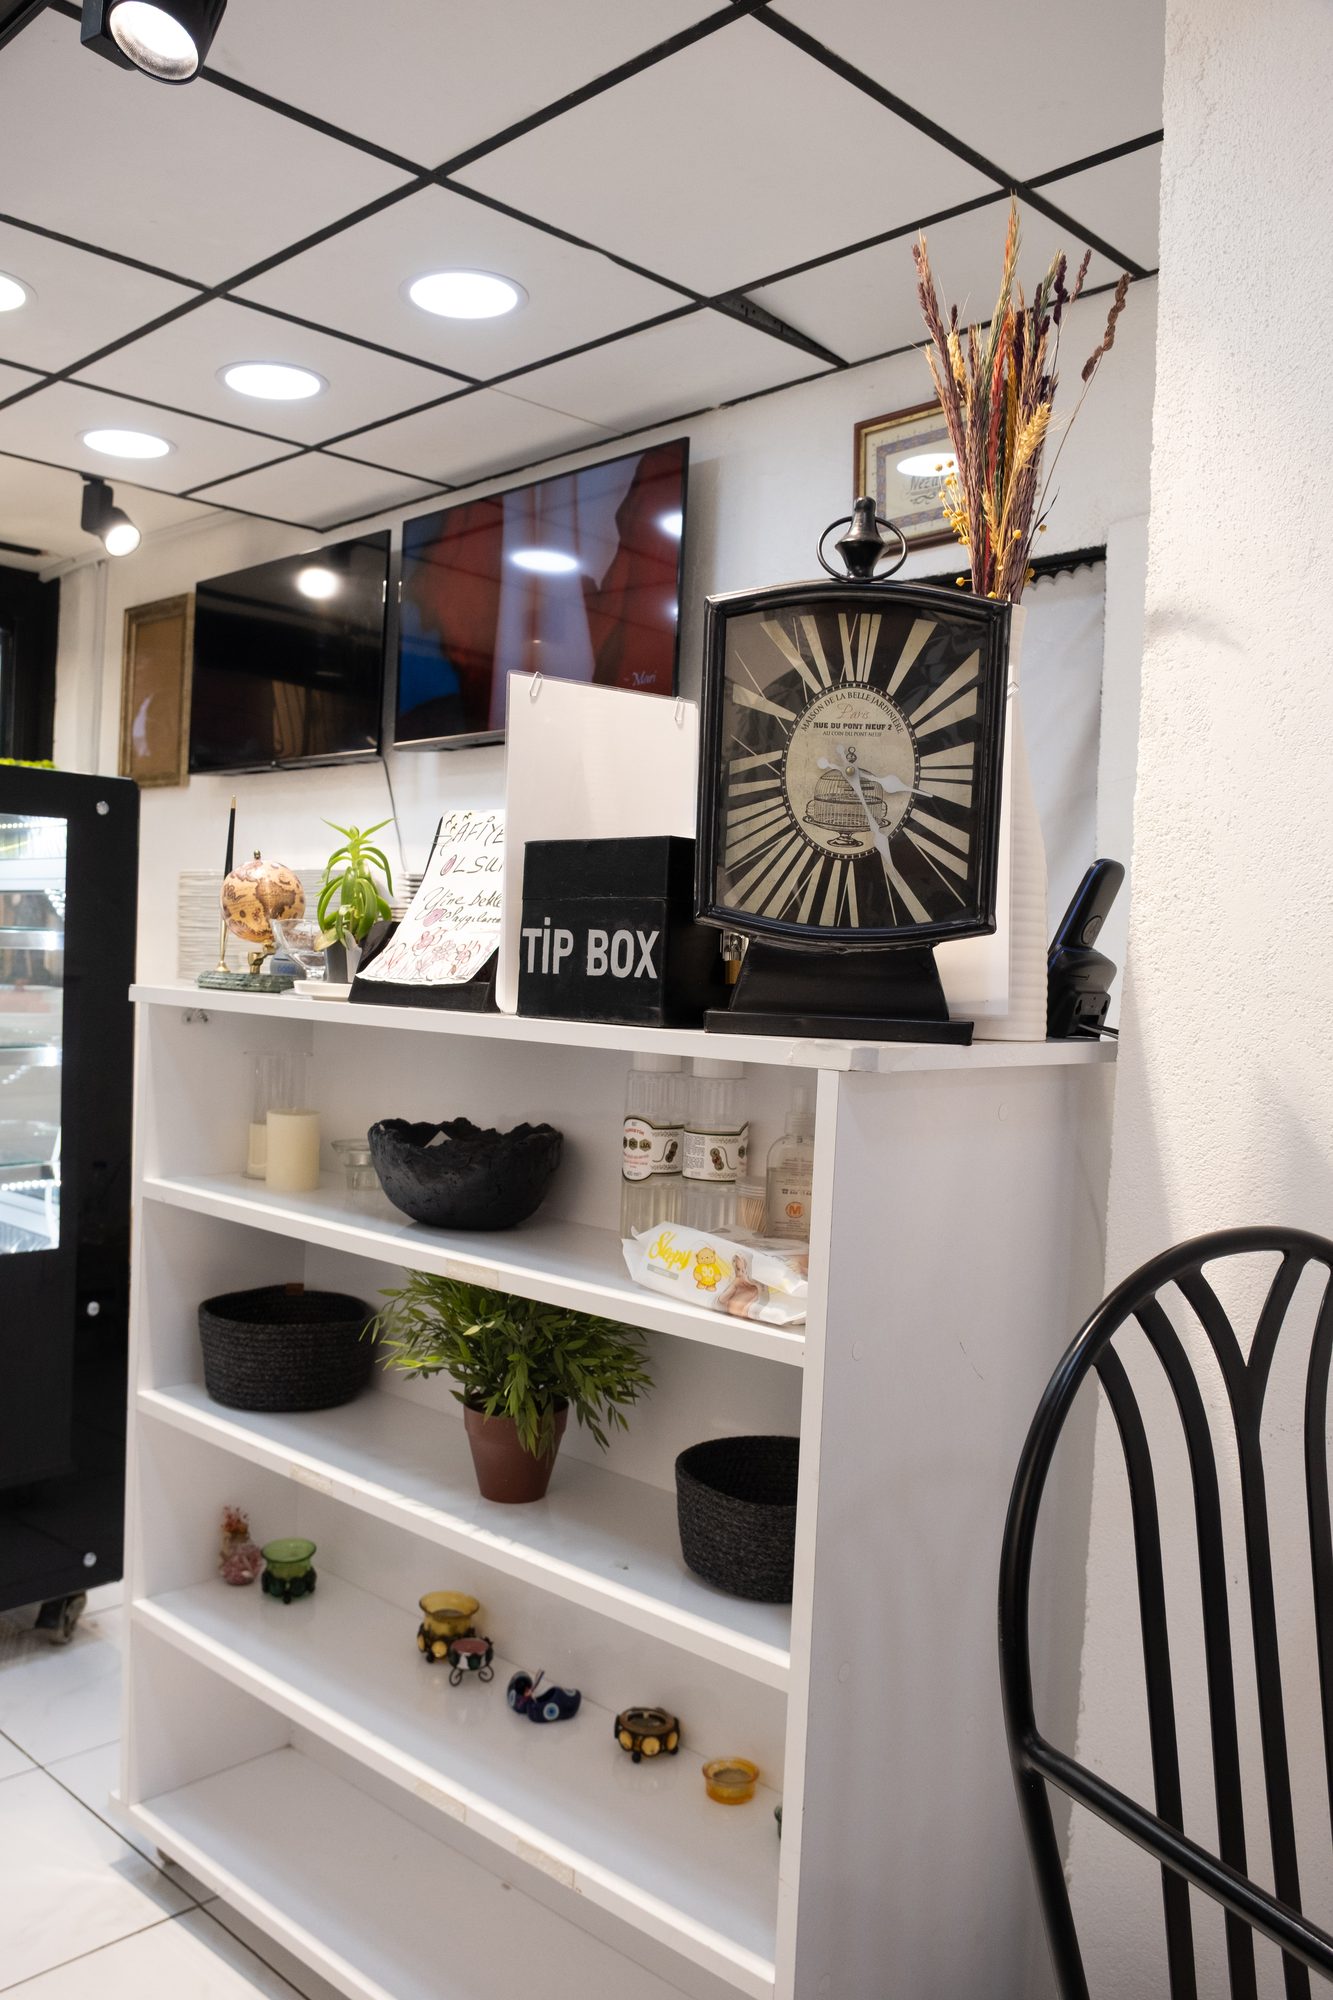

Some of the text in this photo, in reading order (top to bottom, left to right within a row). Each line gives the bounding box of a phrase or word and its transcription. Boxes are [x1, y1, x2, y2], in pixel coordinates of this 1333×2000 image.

[801, 704, 825, 732] MAISON
[824, 697, 834, 707] DE
[835, 692, 846, 701] LA
[847, 691, 870, 701] BELLE
[836, 703, 870, 719] Paris
[843, 722, 863, 730] PONT
[865, 723, 886, 731] NEUF
[586, 929, 660, 979] BOX
